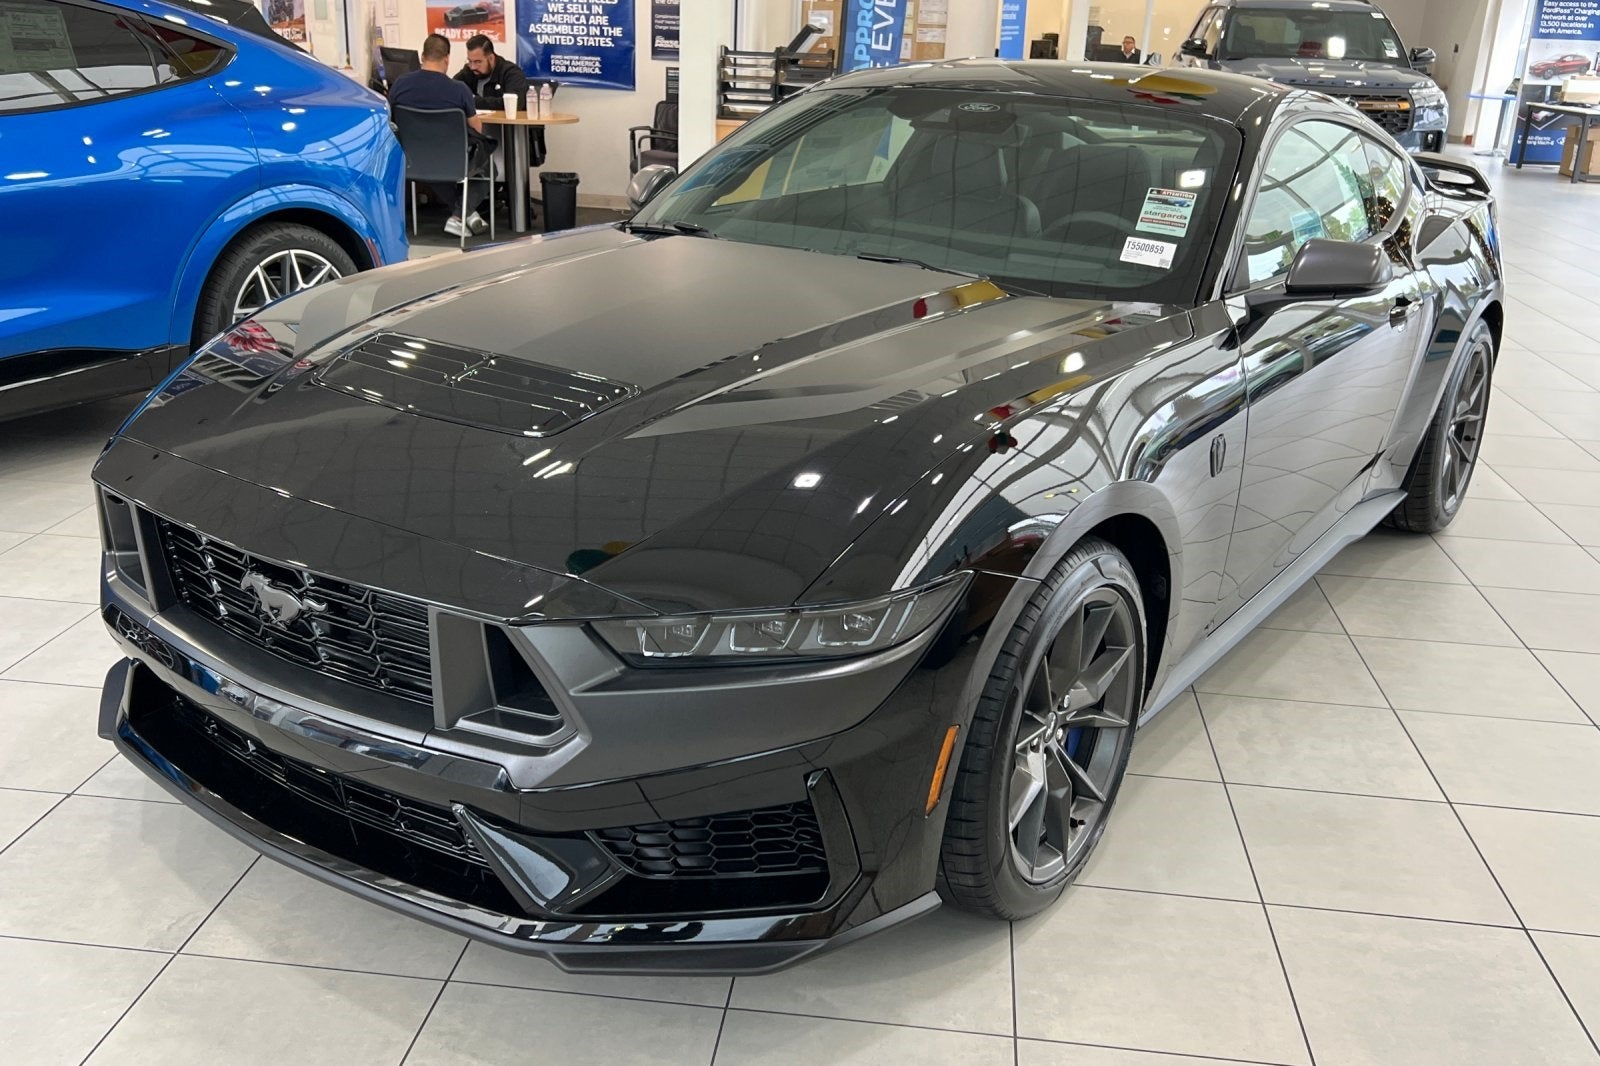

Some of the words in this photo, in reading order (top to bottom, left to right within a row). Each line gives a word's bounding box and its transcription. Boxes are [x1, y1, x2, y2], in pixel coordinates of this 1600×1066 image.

[547, 3, 564, 12] WE
[566, 4, 589, 14] SELL
[592, 5, 602, 14] IN
[542, 14, 586, 25] AMERICA
[589, 15, 609, 25] ARE
[529, 24, 587, 35] ASSEMBLED
[589, 26, 600, 36] IN
[602, 27, 623, 37] THE
[537, 35, 575, 46] UNITED
[576, 37, 615, 48] STATES.
[1162, 191, 1194, 199] ATTENTION
[1126, 240, 1165, 255] T5500859
